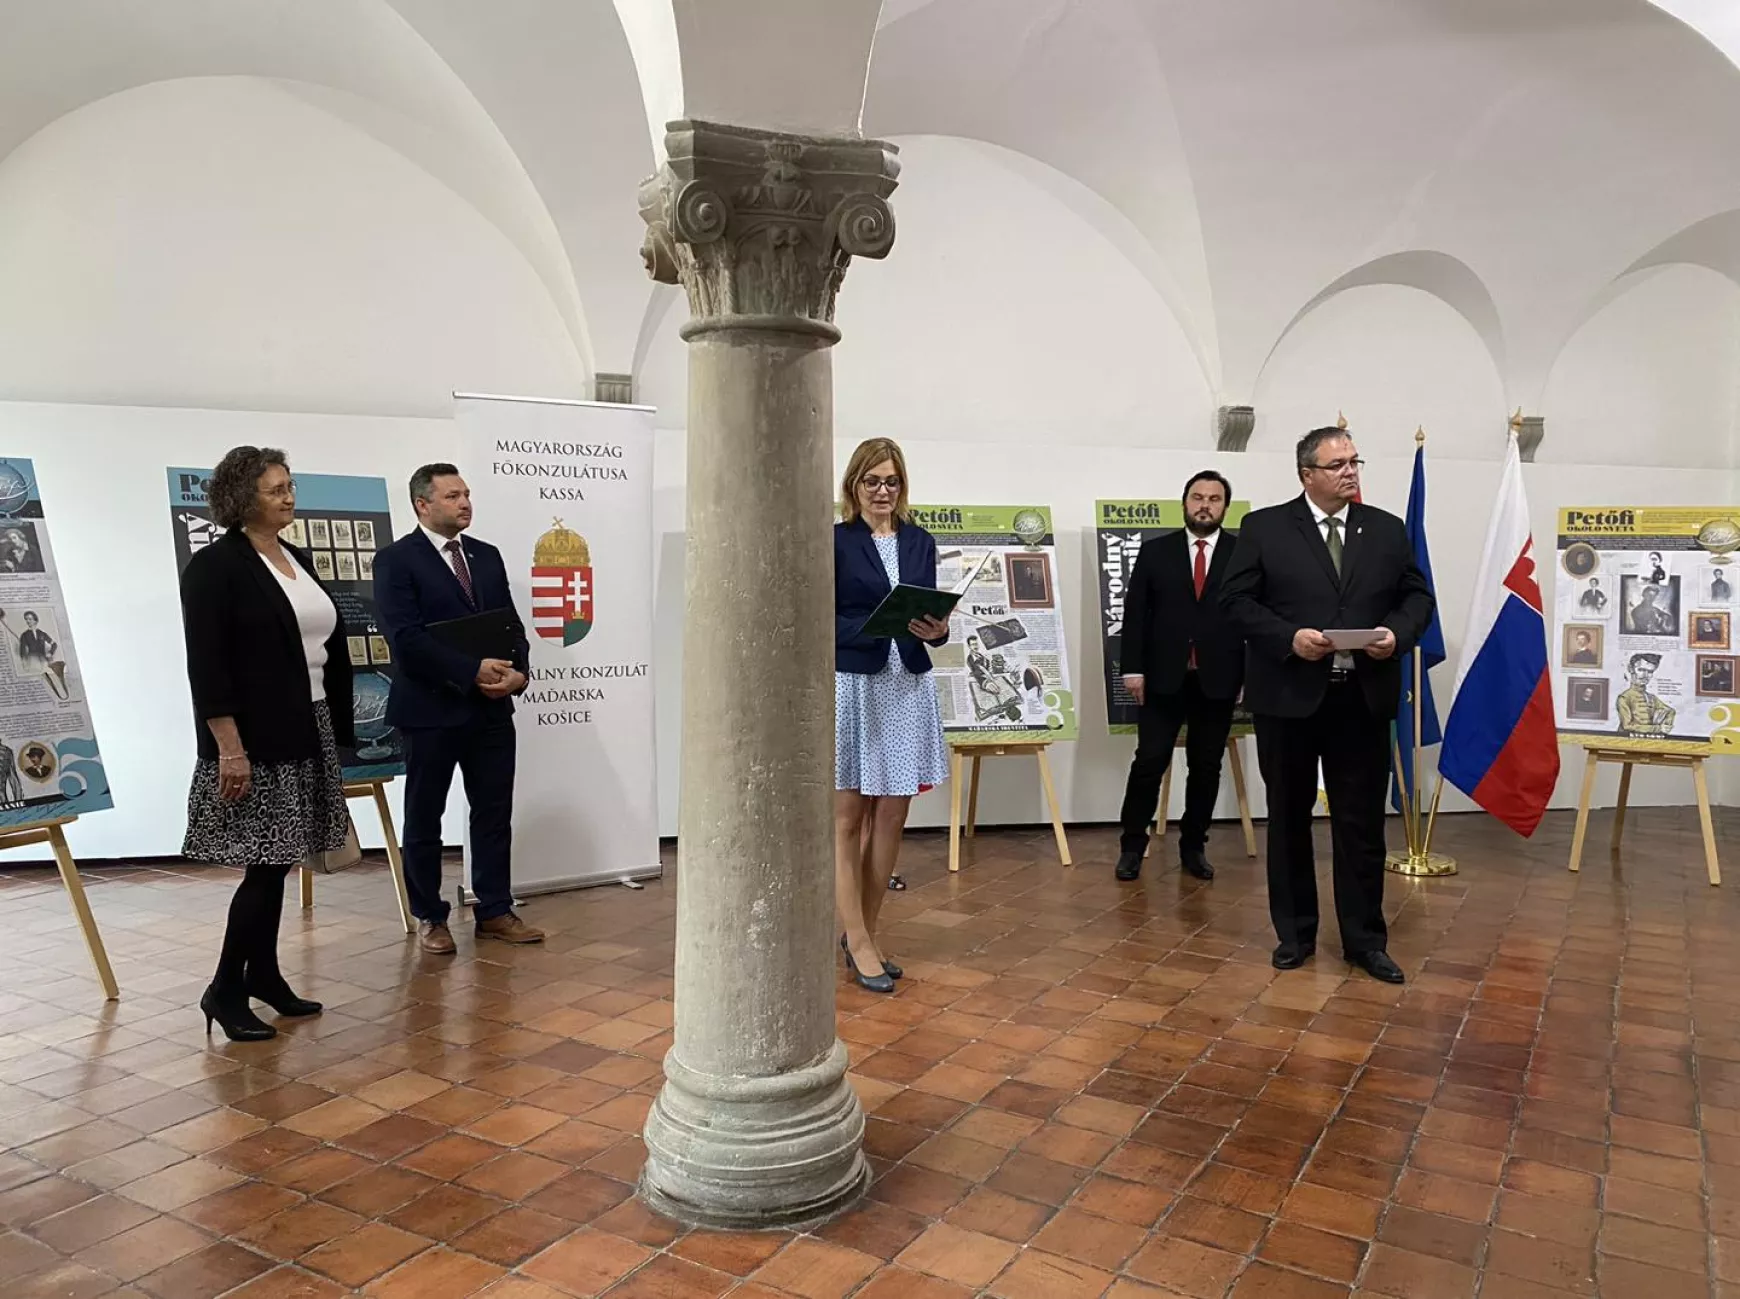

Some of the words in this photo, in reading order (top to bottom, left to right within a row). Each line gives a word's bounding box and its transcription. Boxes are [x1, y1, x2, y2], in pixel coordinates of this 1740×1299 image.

[496, 439, 623, 458] MAGYARORSZÁG
[493, 460, 628, 480] FŐKONZULÁTUSA
[540, 487, 584, 501] KASSA
[1103, 502, 1160, 518] Petőfi
[1567, 509, 1635, 525] Petőfi
[1101, 532, 1125, 637] Národný
[571, 662, 649, 679] KONZULÁT
[522, 688, 605, 704] MAĎARSKA
[537, 709, 592, 726] KOŠICE
